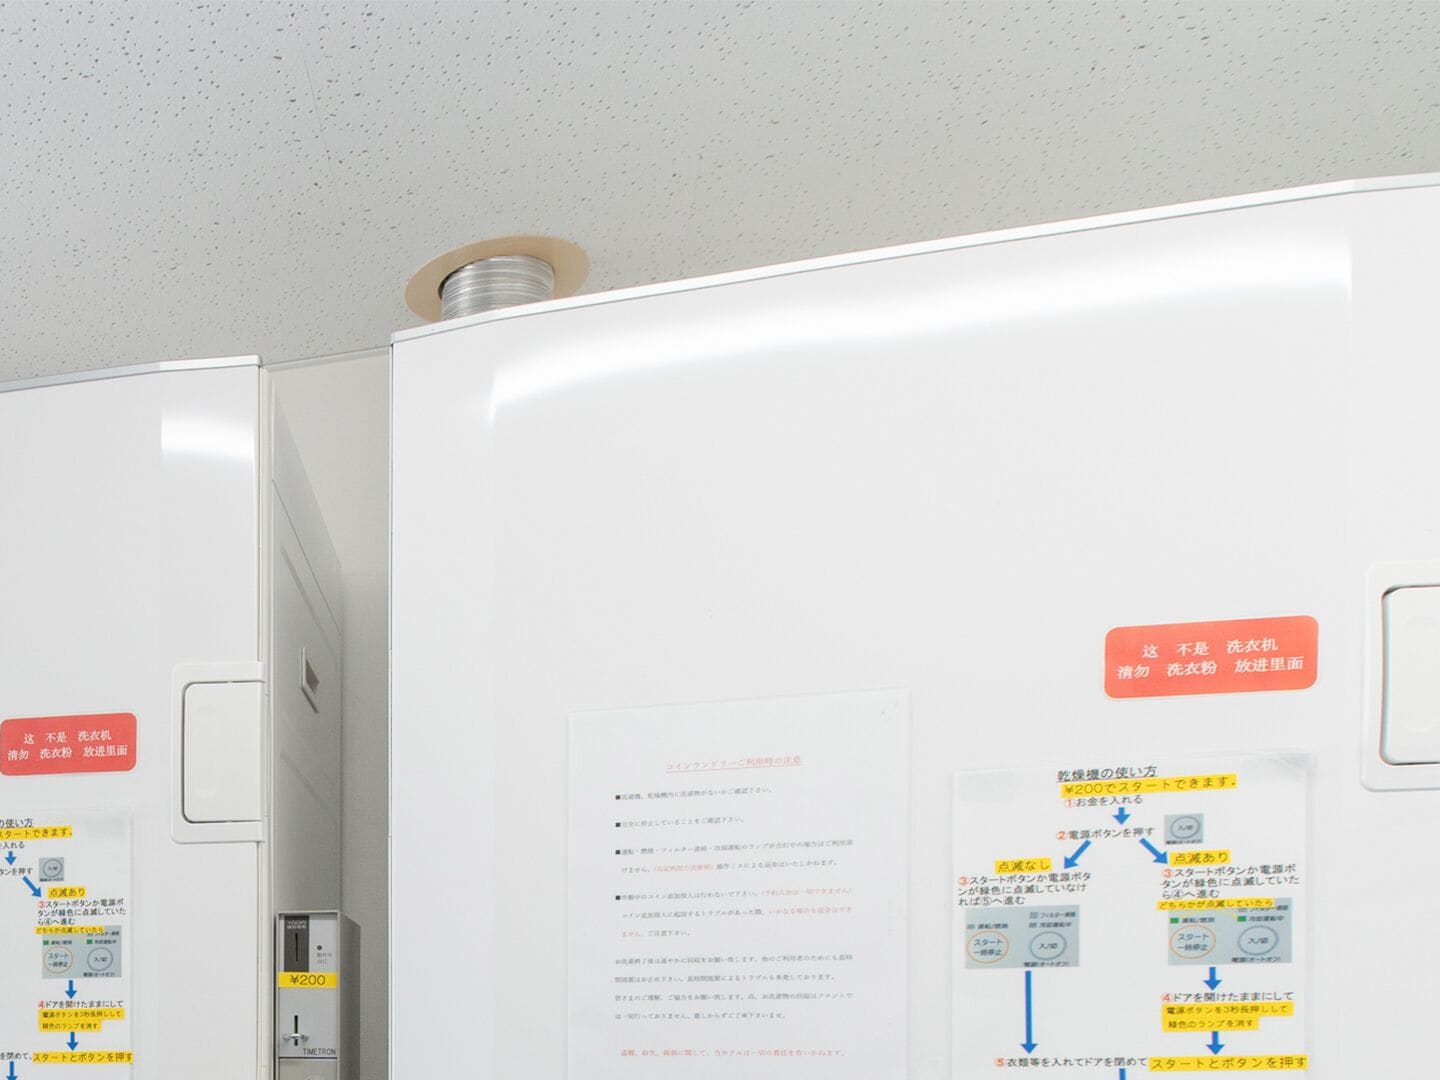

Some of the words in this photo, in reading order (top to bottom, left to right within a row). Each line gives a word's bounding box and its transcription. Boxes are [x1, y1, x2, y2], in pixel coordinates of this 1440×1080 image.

[1142, 644, 1159, 659] 这
[1176, 641, 1209, 657] 不是
[1226, 638, 1279, 654] 洗衣机
[1166, 660, 1218, 677] 洗衣粉
[1234, 655, 1305, 673] 放进里面
[23, 733, 35, 745] 这
[45, 731, 67, 743] 不是
[77, 730, 111, 742] 洗衣机
[39, 746, 73, 759] 洗衣粉
[83, 744, 128, 758] 放进里面
[1057, 766, 1158, 783] 乾燥機の使い方
[1064, 795, 1144, 808] ①お金を入れる
[1056, 827, 1156, 840] ②電源ボタンを押す
[1174, 852, 1229, 865] 点滅あり
[998, 860, 1050, 873] 点滅なし
[1161, 876, 1300, 889] タンが緑色に点滅していた
[49, 887, 86, 898] 点滅あり
[958, 883, 1088, 896] ンが緑色に点滅していなけ
[1162, 889, 1220, 899] ら④へ進む
[958, 896, 1026, 906] れば⑤へ進む
[1177, 933, 1209, 941] スタート
[291, 974, 326, 985] ¥200
[1161, 991, 1295, 1003] ④ドアを開けたままにして
[1166, 1004, 1288, 1015] 電源ボタンを3秒長押しして
[1167, 1019, 1254, 1029] 緑色のランプを消す
[33, 1051, 134, 1063] スタートとボタンを押す
[1151, 1057, 1308, 1070] スタートとボタンを押す
